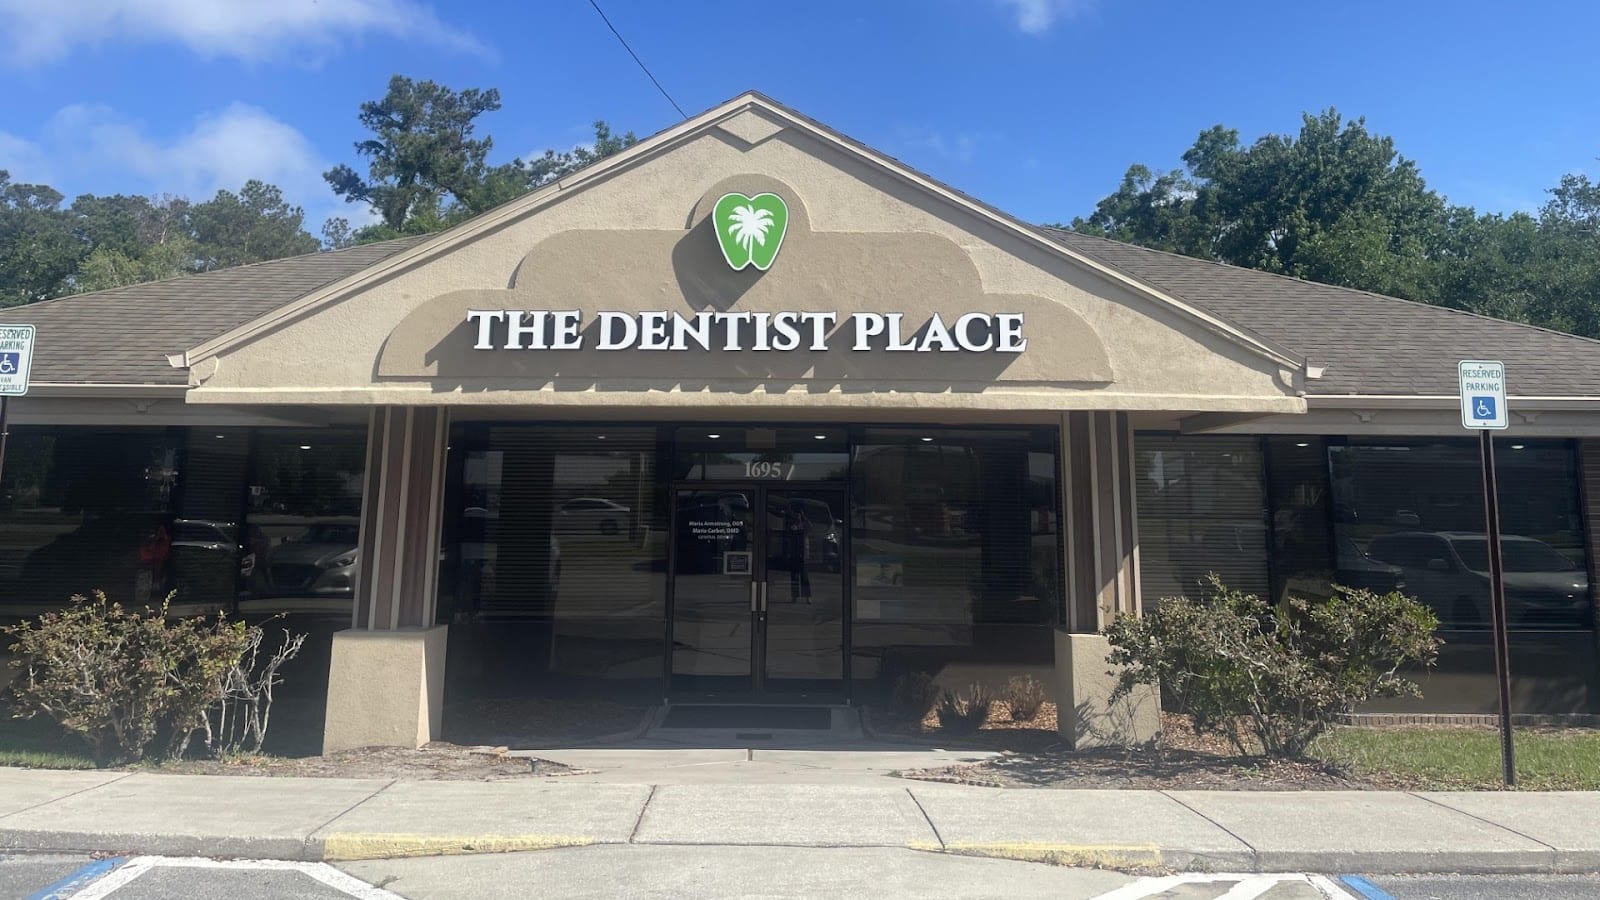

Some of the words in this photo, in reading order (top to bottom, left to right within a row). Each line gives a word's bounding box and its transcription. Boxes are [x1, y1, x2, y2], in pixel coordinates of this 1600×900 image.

[0, 329, 30, 339] SERVED
[467, 309, 583, 350] THE
[595, 310, 837, 351] DENTIST
[852, 312, 1028, 352] PLACE
[0, 341, 25, 350] ARKING
[1463, 369, 1501, 379] RESERVED
[1466, 382, 1500, 391] PARKING
